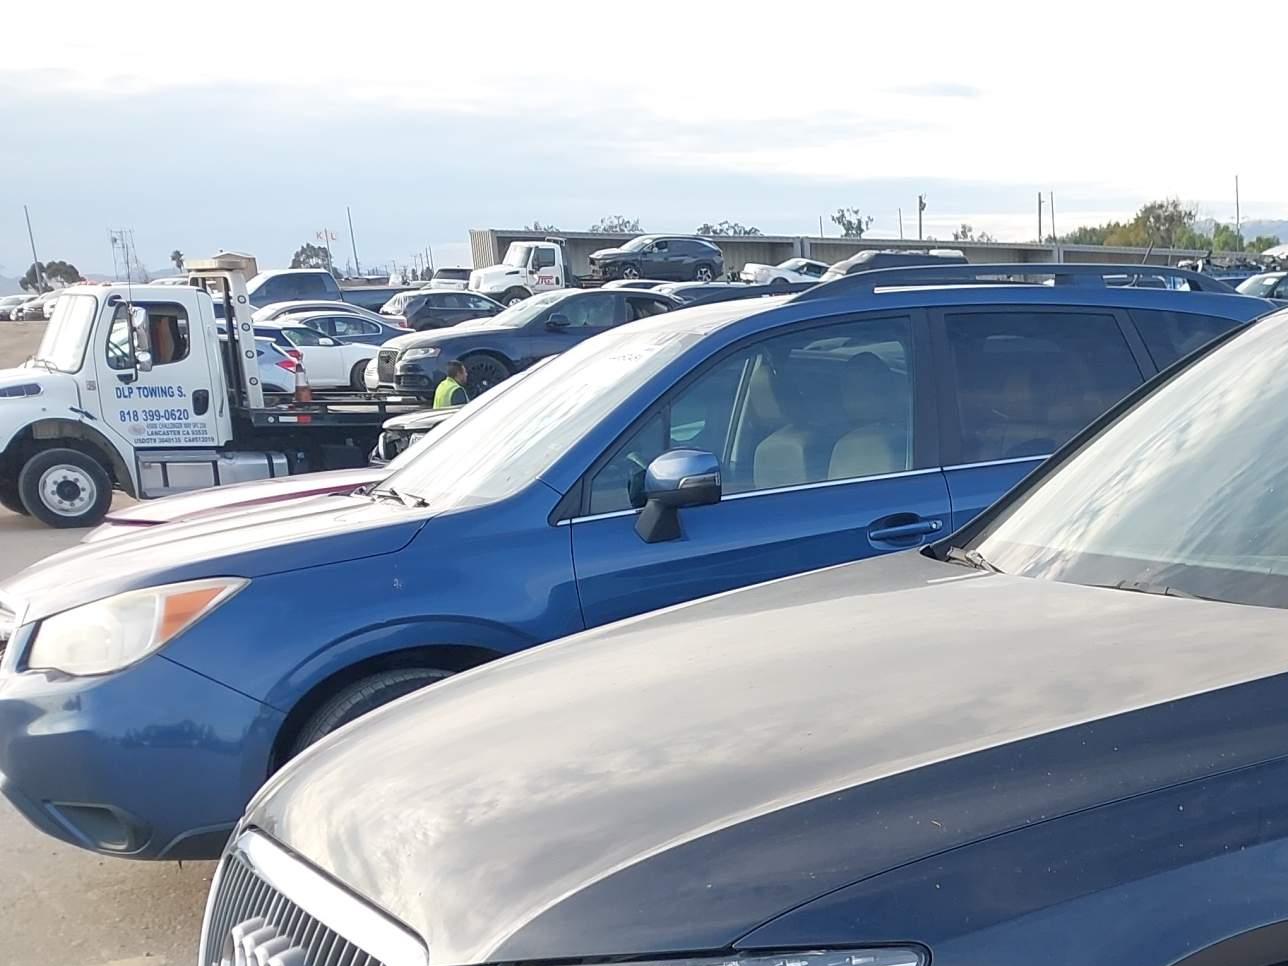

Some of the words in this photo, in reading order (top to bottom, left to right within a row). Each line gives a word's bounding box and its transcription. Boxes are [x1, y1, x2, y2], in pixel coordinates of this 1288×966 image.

[115, 387, 133, 399] DLP
[136, 386, 175, 399] TOWING
[177, 386, 187, 398] S.
[120, 410, 139, 422] 818
[142, 409, 189, 422] 399-0620
